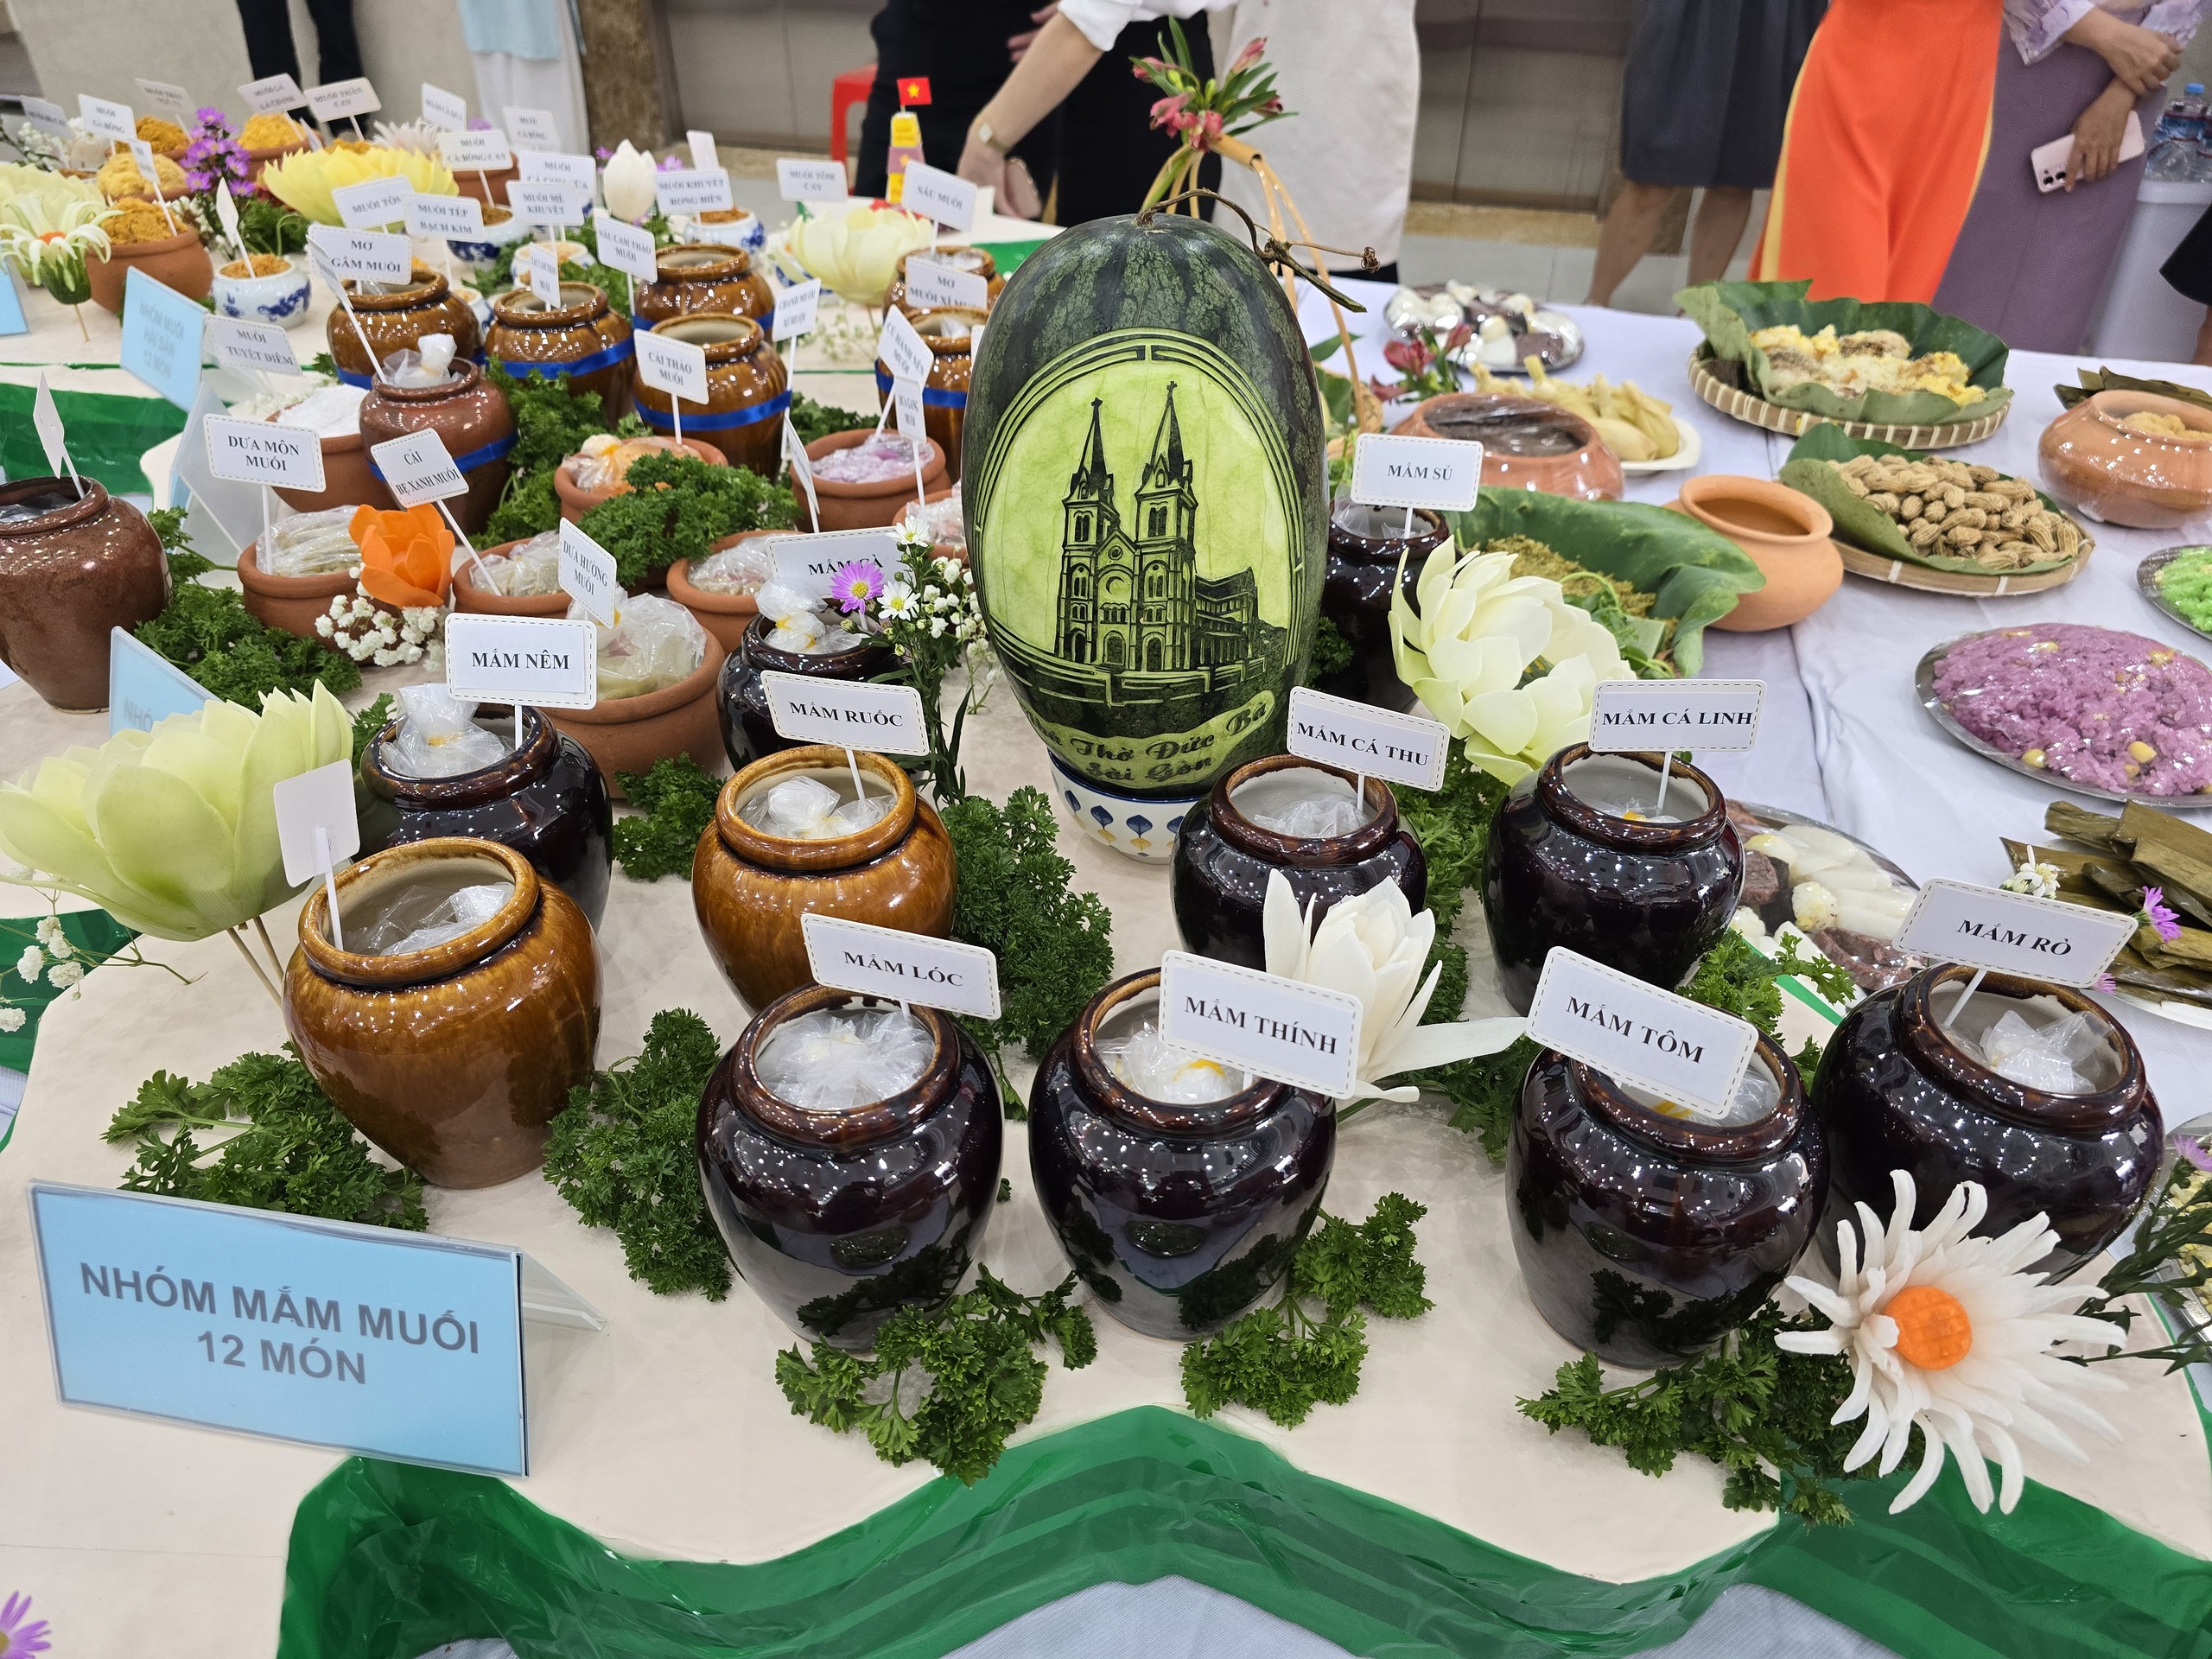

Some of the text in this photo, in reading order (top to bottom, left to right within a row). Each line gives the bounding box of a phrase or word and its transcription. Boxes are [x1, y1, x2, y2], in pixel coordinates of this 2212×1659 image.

[353, 200, 381, 213] MUỐI
[418, 204, 447, 215] MUỐI
[938, 193, 963, 211] MUỐI
[452, 225, 473, 234] KIM
[351, 239, 373, 251] MƠ
[366, 259, 402, 273] MUỐI
[938, 275, 956, 289] MƠ
[910, 287, 938, 303] MUỐI
[237, 328, 267, 345] MUỐI
[228, 345, 263, 363] TUYẾT
[659, 369, 684, 386] MUỐI
[228, 435, 299, 456] DƯA MÔN
[245, 454, 288, 472] MUỐI
[404, 448, 423, 466] CẢI
[1387, 461, 1428, 480] MẮM
[396, 467, 461, 496] BẸ XANH MUỐI
[563, 539, 608, 587] DƯA HƯỜNG
[574, 569, 594, 596] MUỐI
[471, 648, 570, 670] MẮM NÊM
[124, 696, 153, 734] NHÓ
[788, 702, 904, 728] MẮM RUỐC
[1602, 708, 1754, 726] MẮM CÁ LINH
[1070, 737, 1136, 761] Thờ
[1145, 734, 1215, 760] Đức
[1297, 721, 1429, 766] MẮM CÁ THU
[1145, 755, 1213, 782] Gòn
[1955, 918, 2072, 957] MẮM RÒ
[843, 950, 964, 987] MẮM LÓC
[1185, 995, 1338, 1055] MẮM THÍNH
[1566, 995, 1707, 1065] MẮM TÔM
[79, 1262, 480, 1354] NHÓM MẮM MUỐI
[197, 1331, 367, 1385] 12 MÓN
